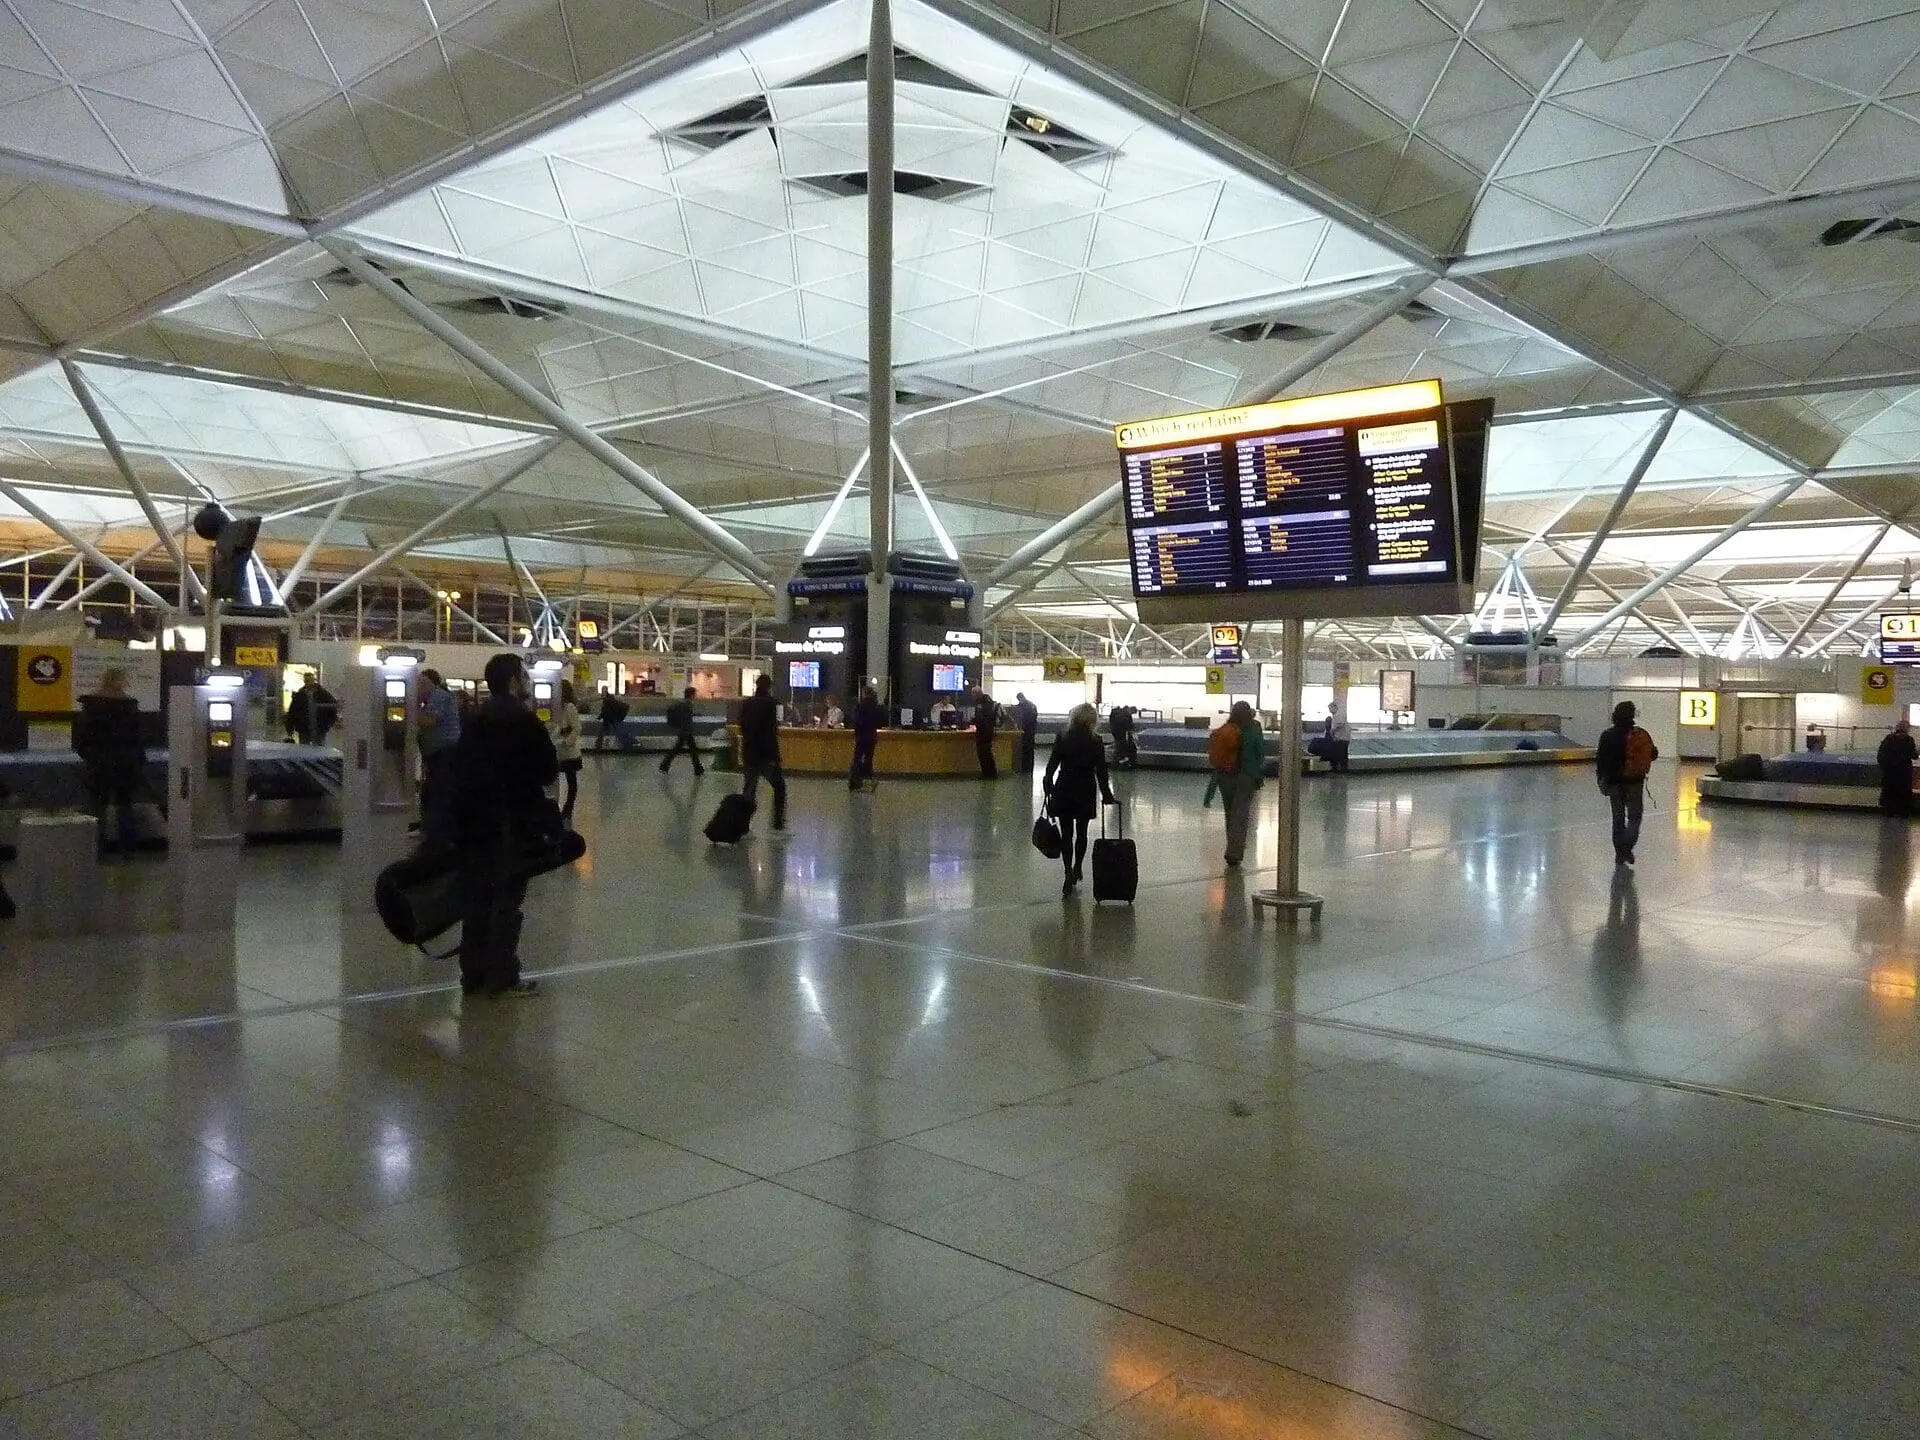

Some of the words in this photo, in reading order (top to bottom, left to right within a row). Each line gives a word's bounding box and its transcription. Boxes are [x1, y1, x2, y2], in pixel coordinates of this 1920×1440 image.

[1908, 619, 1917, 633] 1
[1226, 629, 1236, 641] 2
[1689, 699, 1708, 718] B
